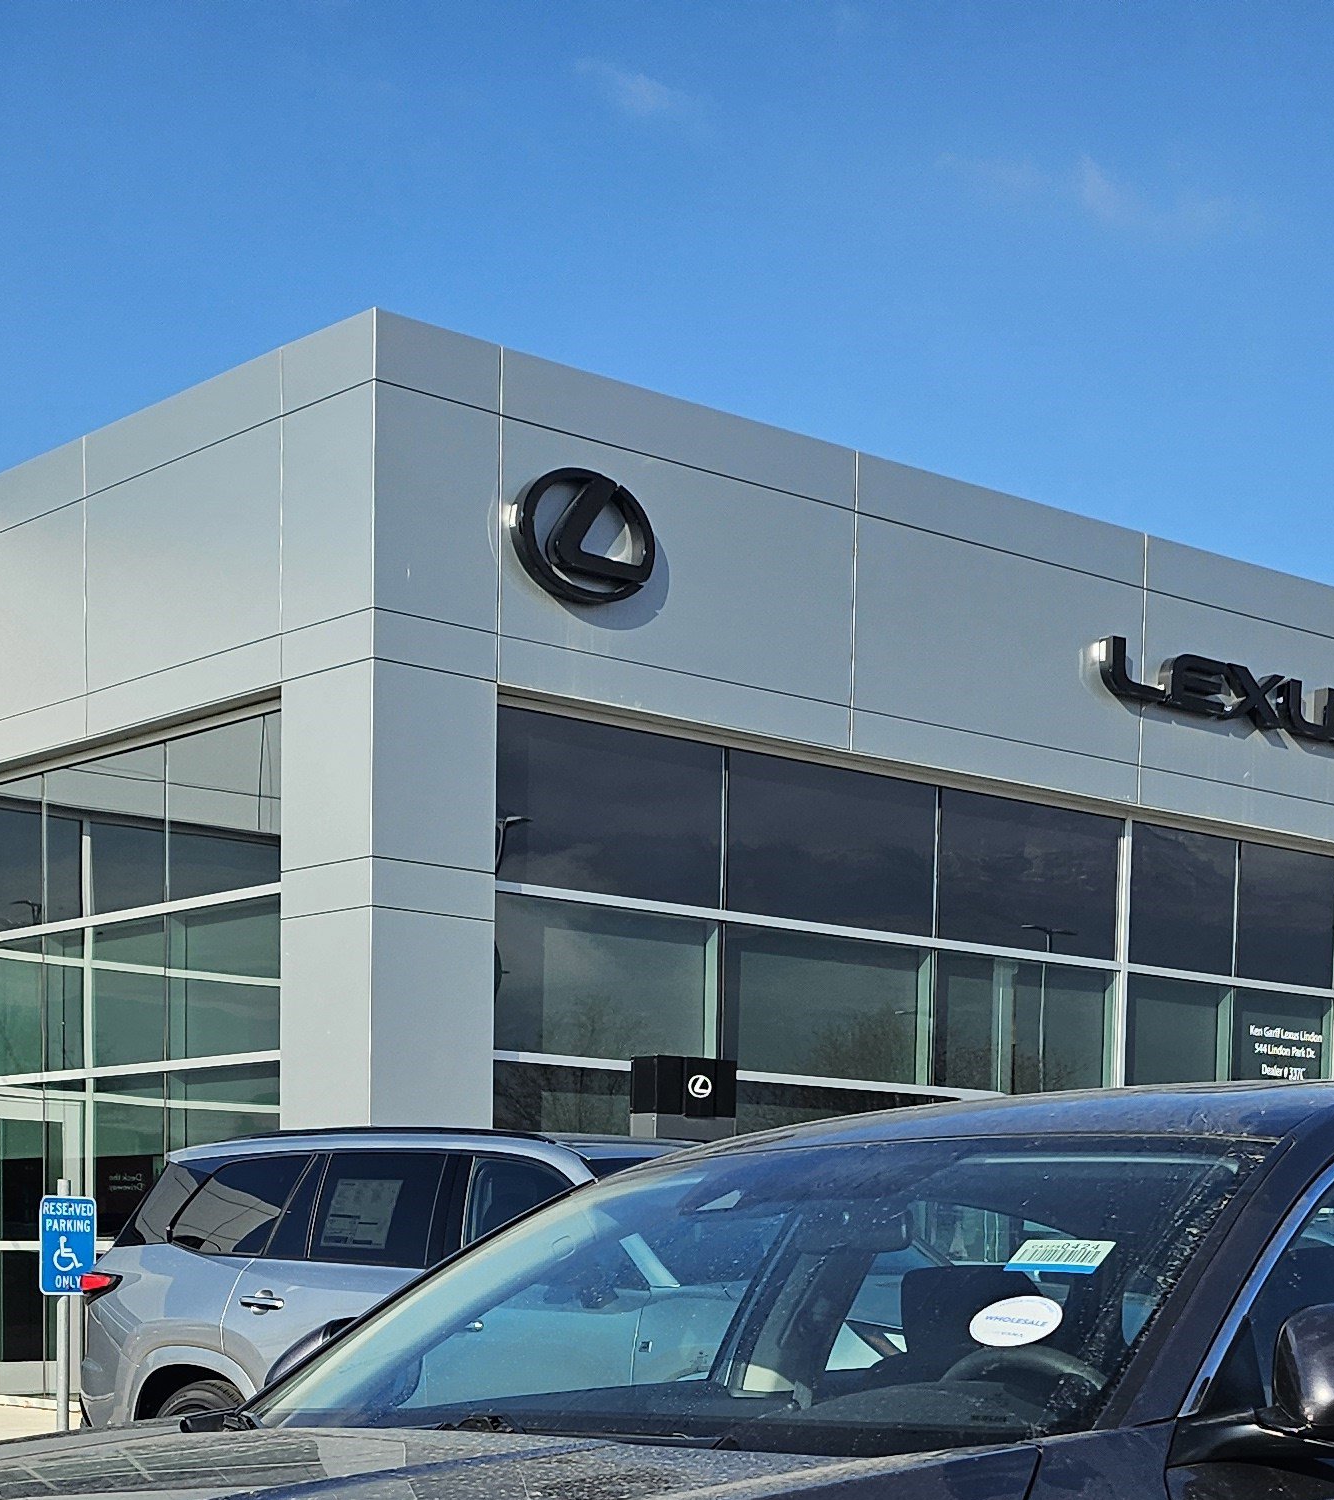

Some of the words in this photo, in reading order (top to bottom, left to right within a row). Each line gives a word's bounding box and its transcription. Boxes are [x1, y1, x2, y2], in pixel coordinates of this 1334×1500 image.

[1300, 1031, 1322, 1043] Lindon
[1268, 1044, 1290, 1056] Lindon
[42, 1202, 93, 1216] RESERVED
[45, 1219, 91, 1232] PARKING
[55, 1275, 81, 1289] ONLY
[985, 1315, 1048, 1327] WHOLESALE
